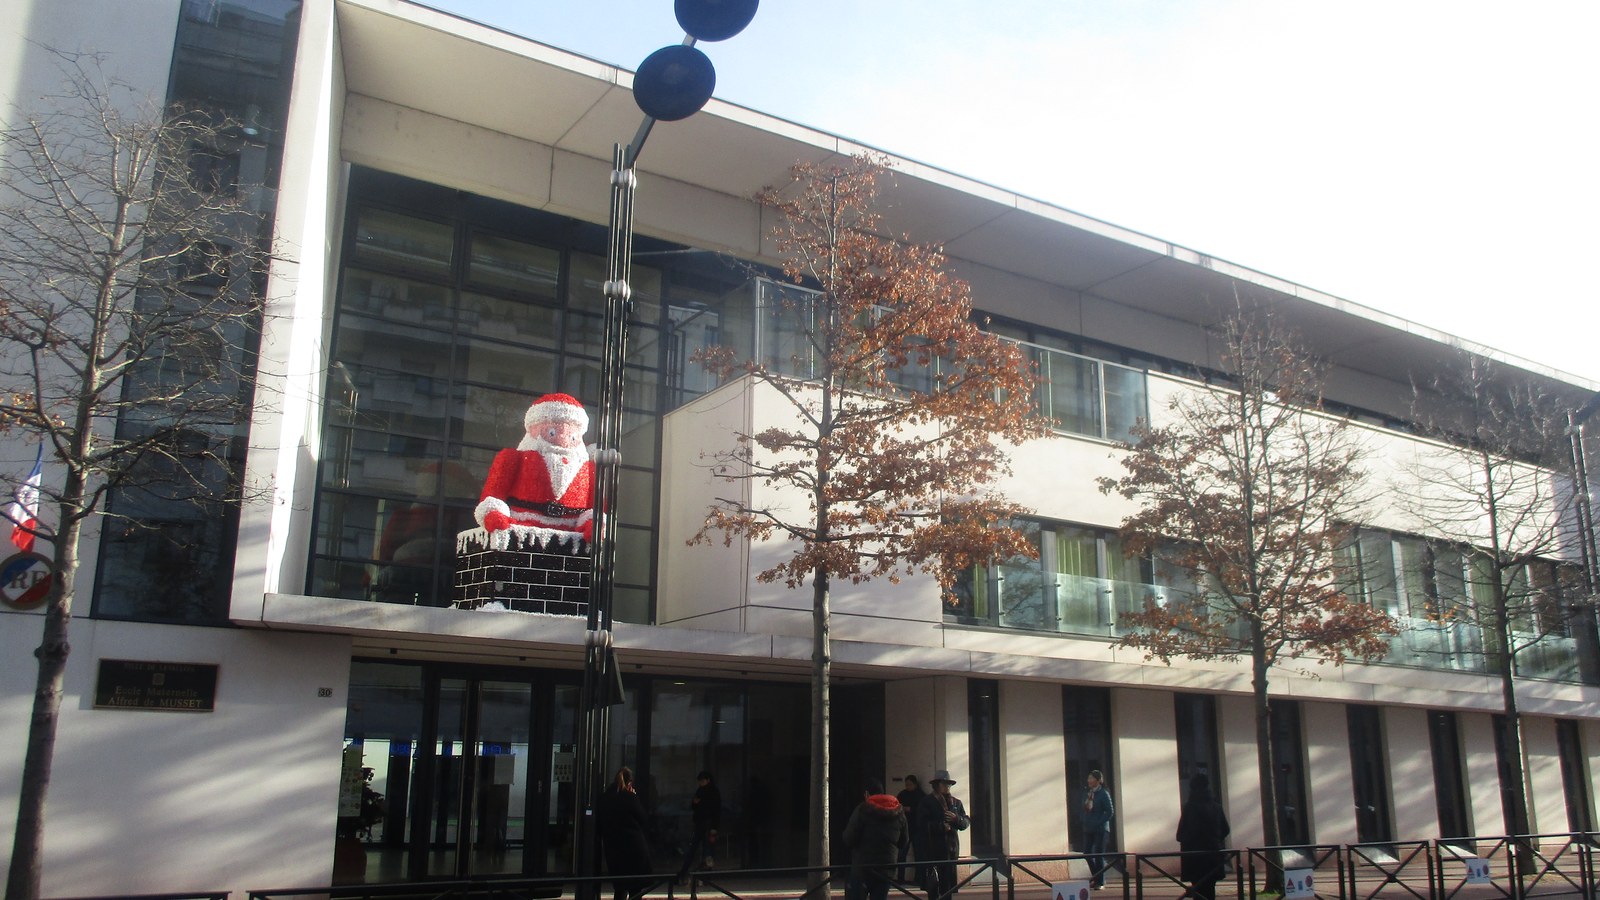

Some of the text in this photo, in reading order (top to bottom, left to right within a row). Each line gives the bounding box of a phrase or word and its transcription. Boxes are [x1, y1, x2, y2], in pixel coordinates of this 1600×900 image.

[10, 570, 47, 589] RF
[108, 696, 203, 708] Alfred de MUSSET
